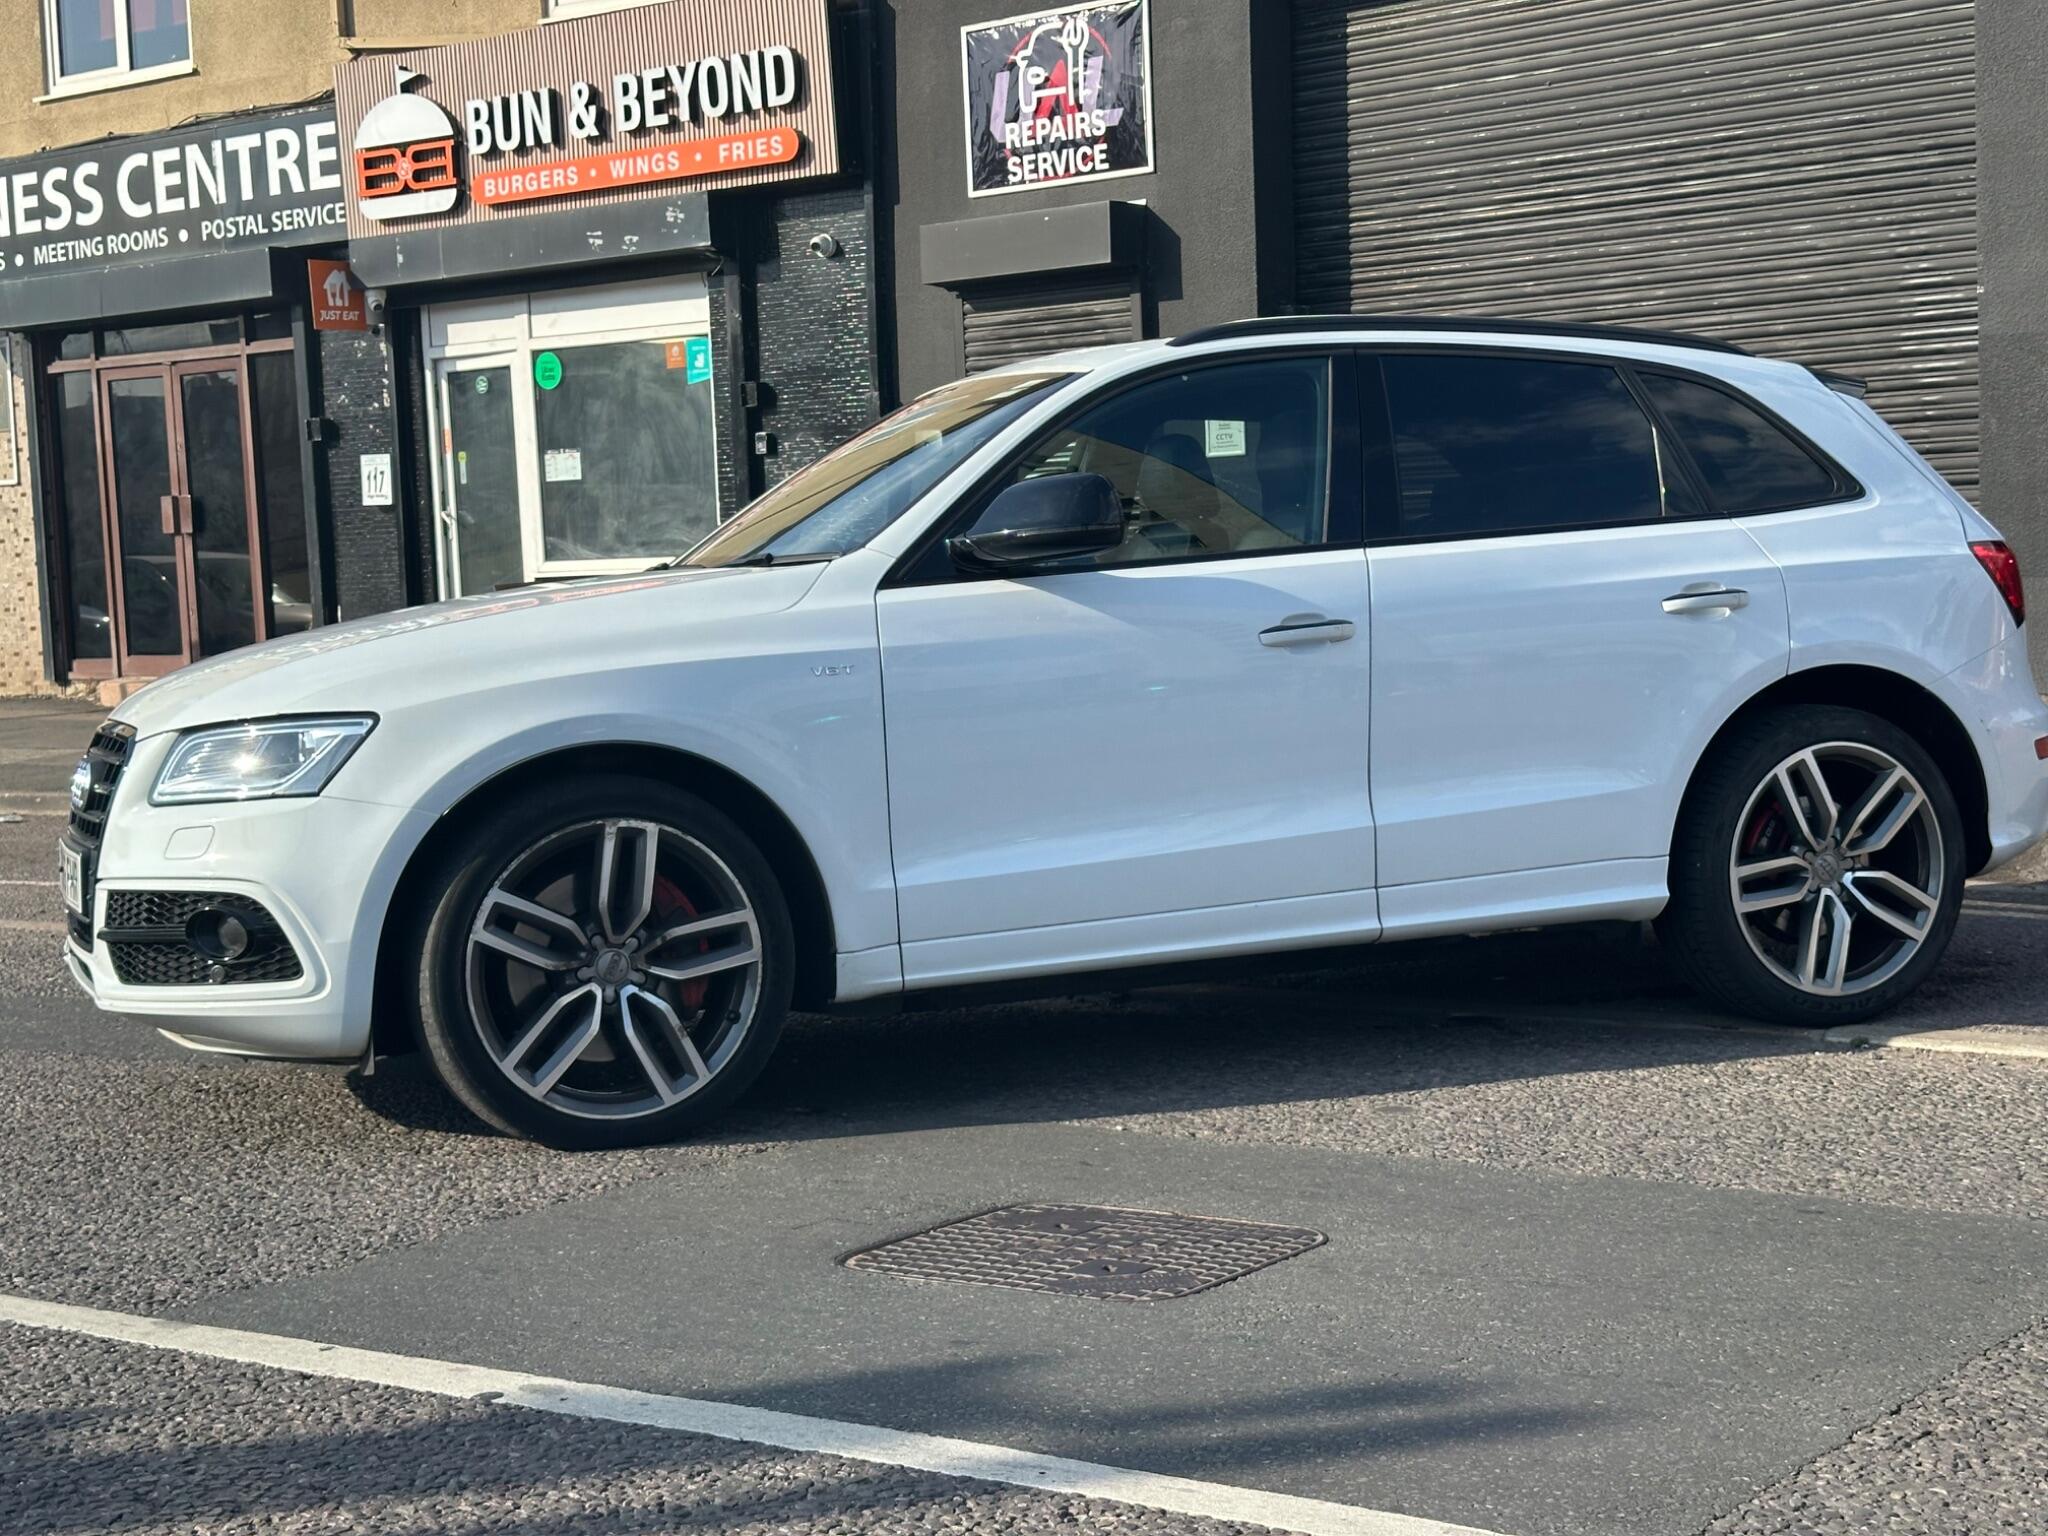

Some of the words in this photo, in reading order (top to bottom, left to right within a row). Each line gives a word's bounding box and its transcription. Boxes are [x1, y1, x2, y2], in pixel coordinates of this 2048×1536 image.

[467, 87, 553, 155] BUN
[569, 81, 600, 139] &
[614, 45, 796, 132] BEYOND
[1005, 109, 1106, 149] REPAIRS
[0, 161, 103, 238] ESS
[117, 121, 341, 218] CENTRE
[484, 167, 579, 197] BURGERS
[609, 151, 680, 179] WINGS
[718, 135, 784, 162] FRIES
[1007, 143, 1110, 182] SERVICE
[34, 236, 104, 266] MEETING
[108, 227, 168, 253] ROOMS
[202, 214, 268, 241] POSTAL
[272, 202, 346, 233] SERVICE
[320, 311, 342, 321] JUST
[343, 311, 359, 321] EAT
[1216, 433, 1233, 441] CCTV
[367, 466, 385, 493] 117
